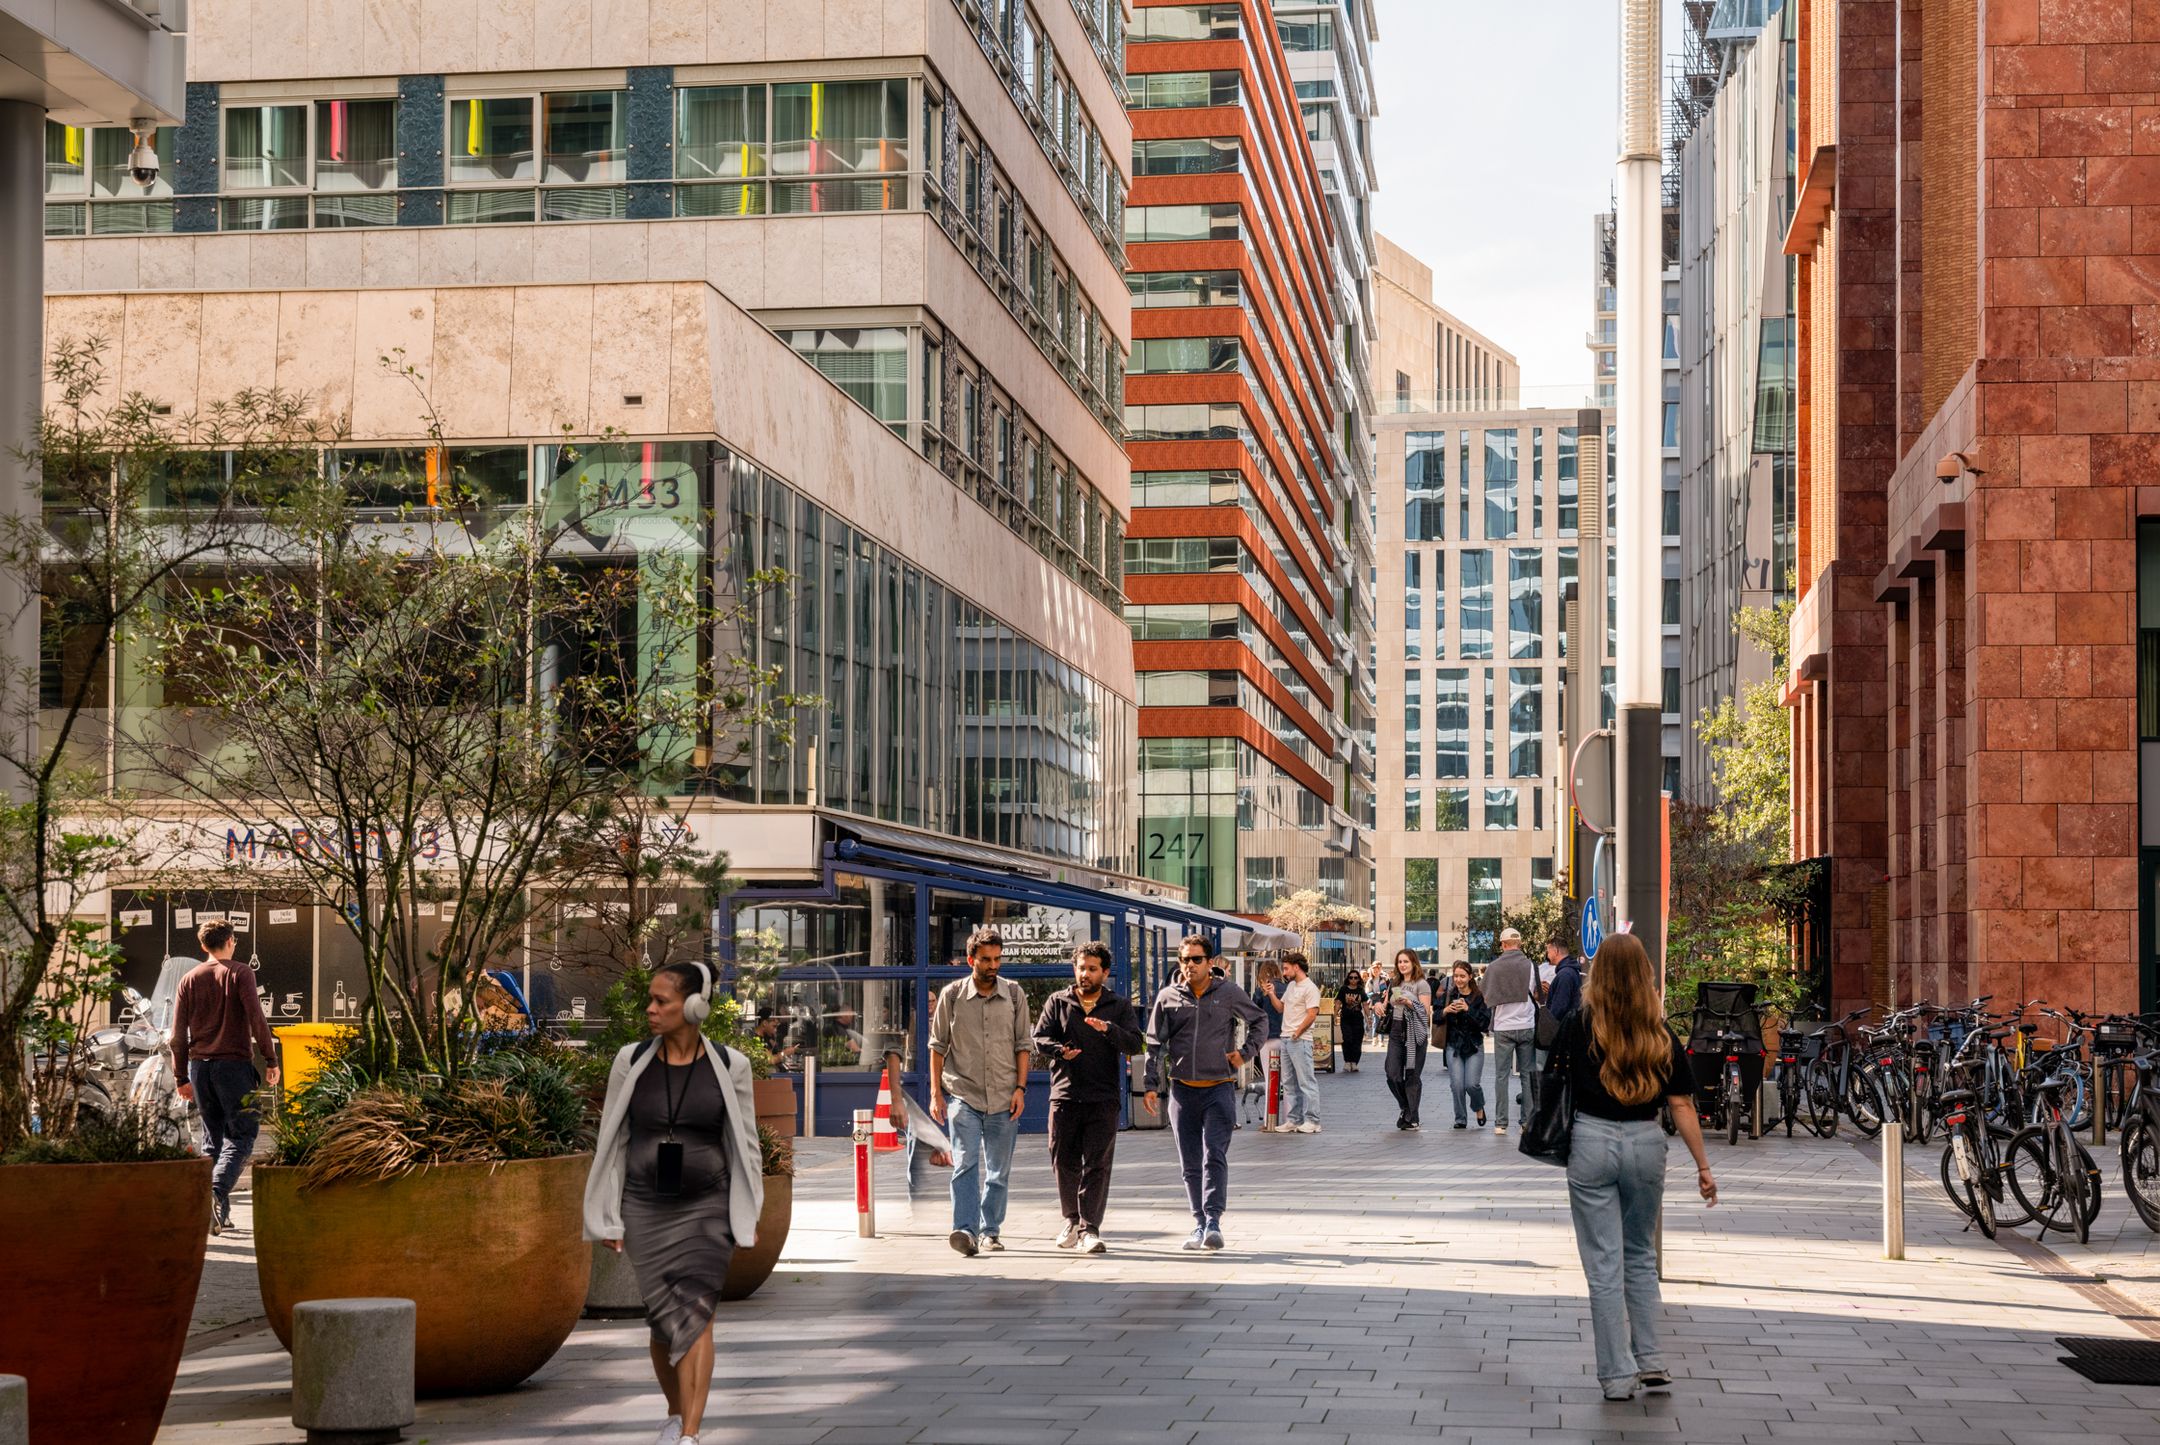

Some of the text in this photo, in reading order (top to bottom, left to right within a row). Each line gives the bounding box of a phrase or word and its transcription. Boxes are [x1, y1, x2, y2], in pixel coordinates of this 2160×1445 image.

[598, 478, 681, 510] M33
[1148, 832, 1205, 860] 247
[1048, 924, 1070, 940] 33
[1000, 947, 1062, 956] RBAN FOODCOURT
